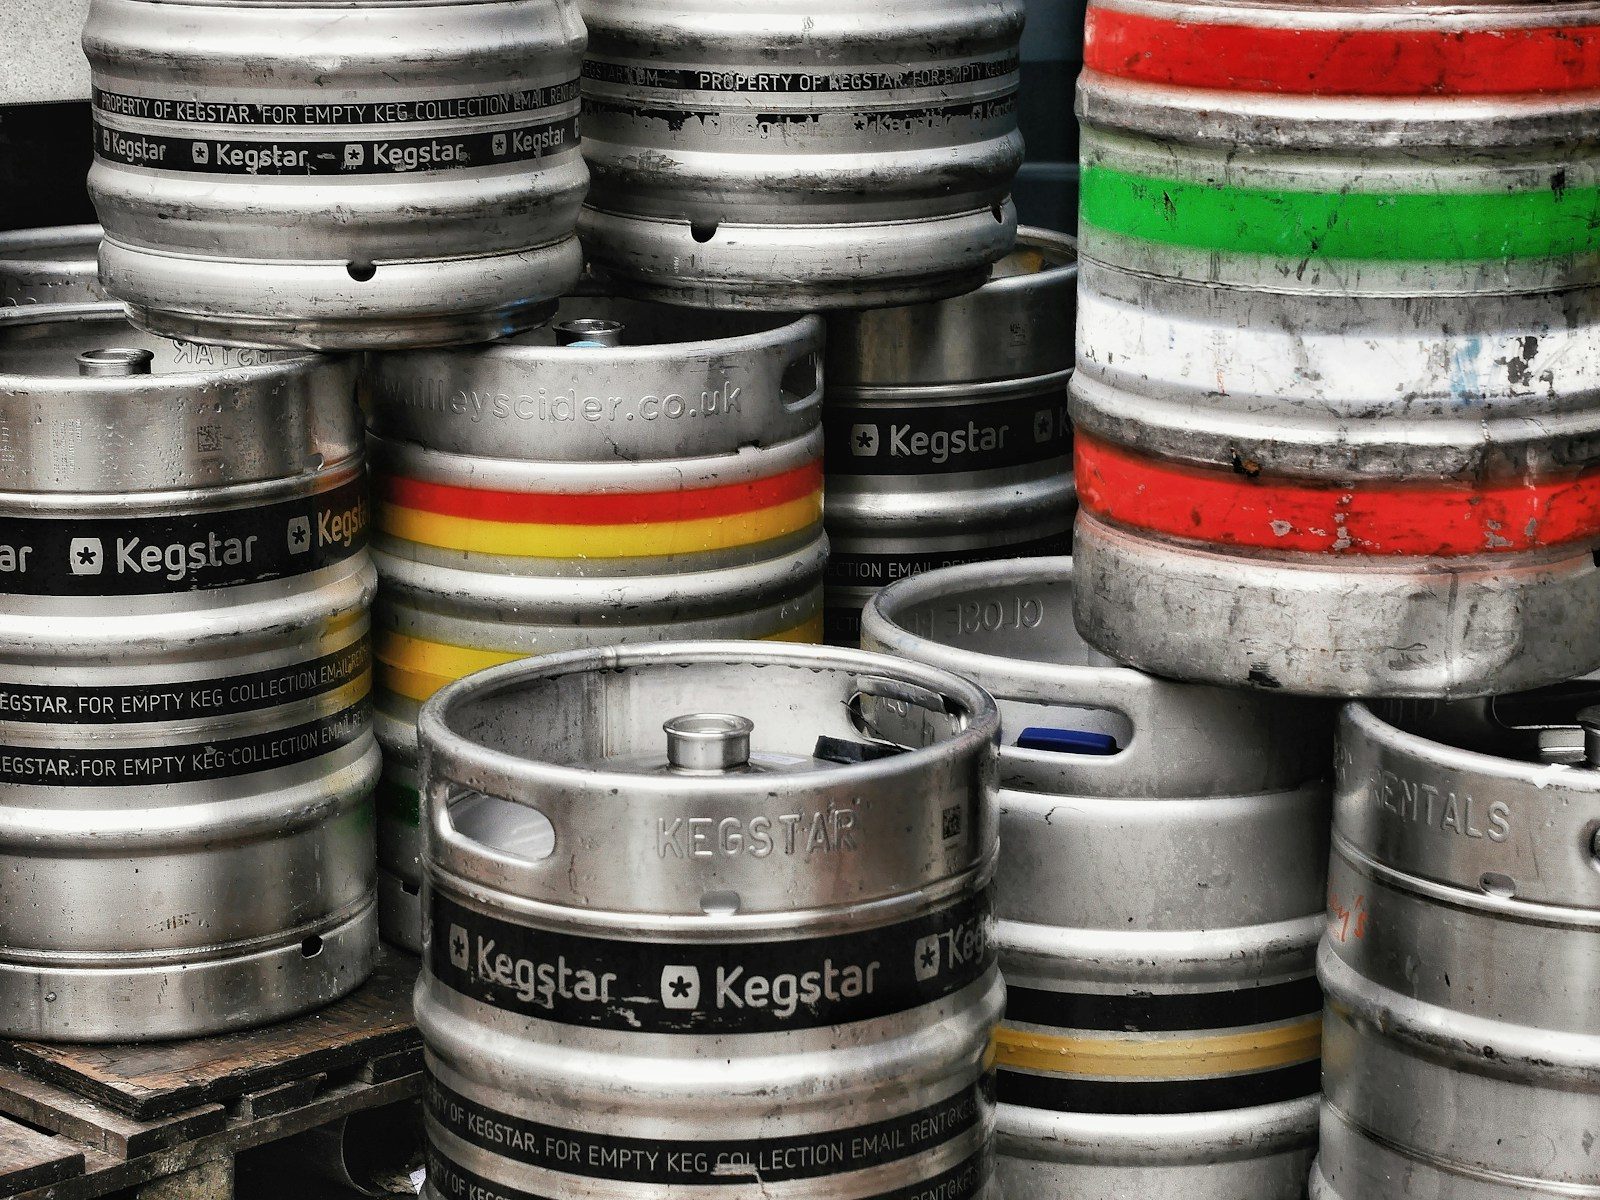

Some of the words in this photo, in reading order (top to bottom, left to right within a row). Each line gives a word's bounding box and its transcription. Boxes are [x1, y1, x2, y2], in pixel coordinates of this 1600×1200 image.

[700, 73, 793, 91] PROPERTY
[799, 75, 822, 91] OF
[945, 65, 981, 84] EMPTY
[101, 92, 150, 117] PROPERTY
[154, 101, 171, 119] OF
[176, 102, 255, 123] KEGSTAR.
[262, 105, 297, 124] FOR
[305, 105, 367, 124] EMPTY
[374, 103, 408, 123] KEG
[415, 93, 510, 120] COLLECTION
[513, 87, 548, 111] EMAIL
[112, 133, 167, 163] Kegstar
[216, 143, 309, 174] Kegstar
[373, 140, 464, 170] Kegstar
[512, 125, 566, 157] Kegstar
[890, 420, 1010, 464] Kegstar
[0, 544, 33, 573] ar
[116, 531, 258, 581] Kegstar
[78, 696, 115, 714] FOR
[121, 692, 184, 714] EMPTY
[190, 688, 223, 709] KEG
[229, 669, 317, 704] COLLECTION
[0, 756, 75, 777] EGSTAR.
[81, 759, 117, 777] FOR
[124, 755, 186, 776] EMPTY
[192, 751, 225, 771] KEG
[231, 729, 318, 766] COLLECTION
[655, 808, 859, 861] KEGSTAR
[477, 935, 617, 1005] Kegstar
[716, 957, 881, 1018] Kegstar
[450, 1102, 465, 1126] OF
[467, 1112, 540, 1155] KEGSTAR.
[545, 1136, 582, 1163] FOR
[588, 1145, 659, 1172] EMPTY
[667, 1152, 708, 1174] KEG
[851, 1129, 905, 1159] EMAIL
[451, 1173, 466, 1197] OF
